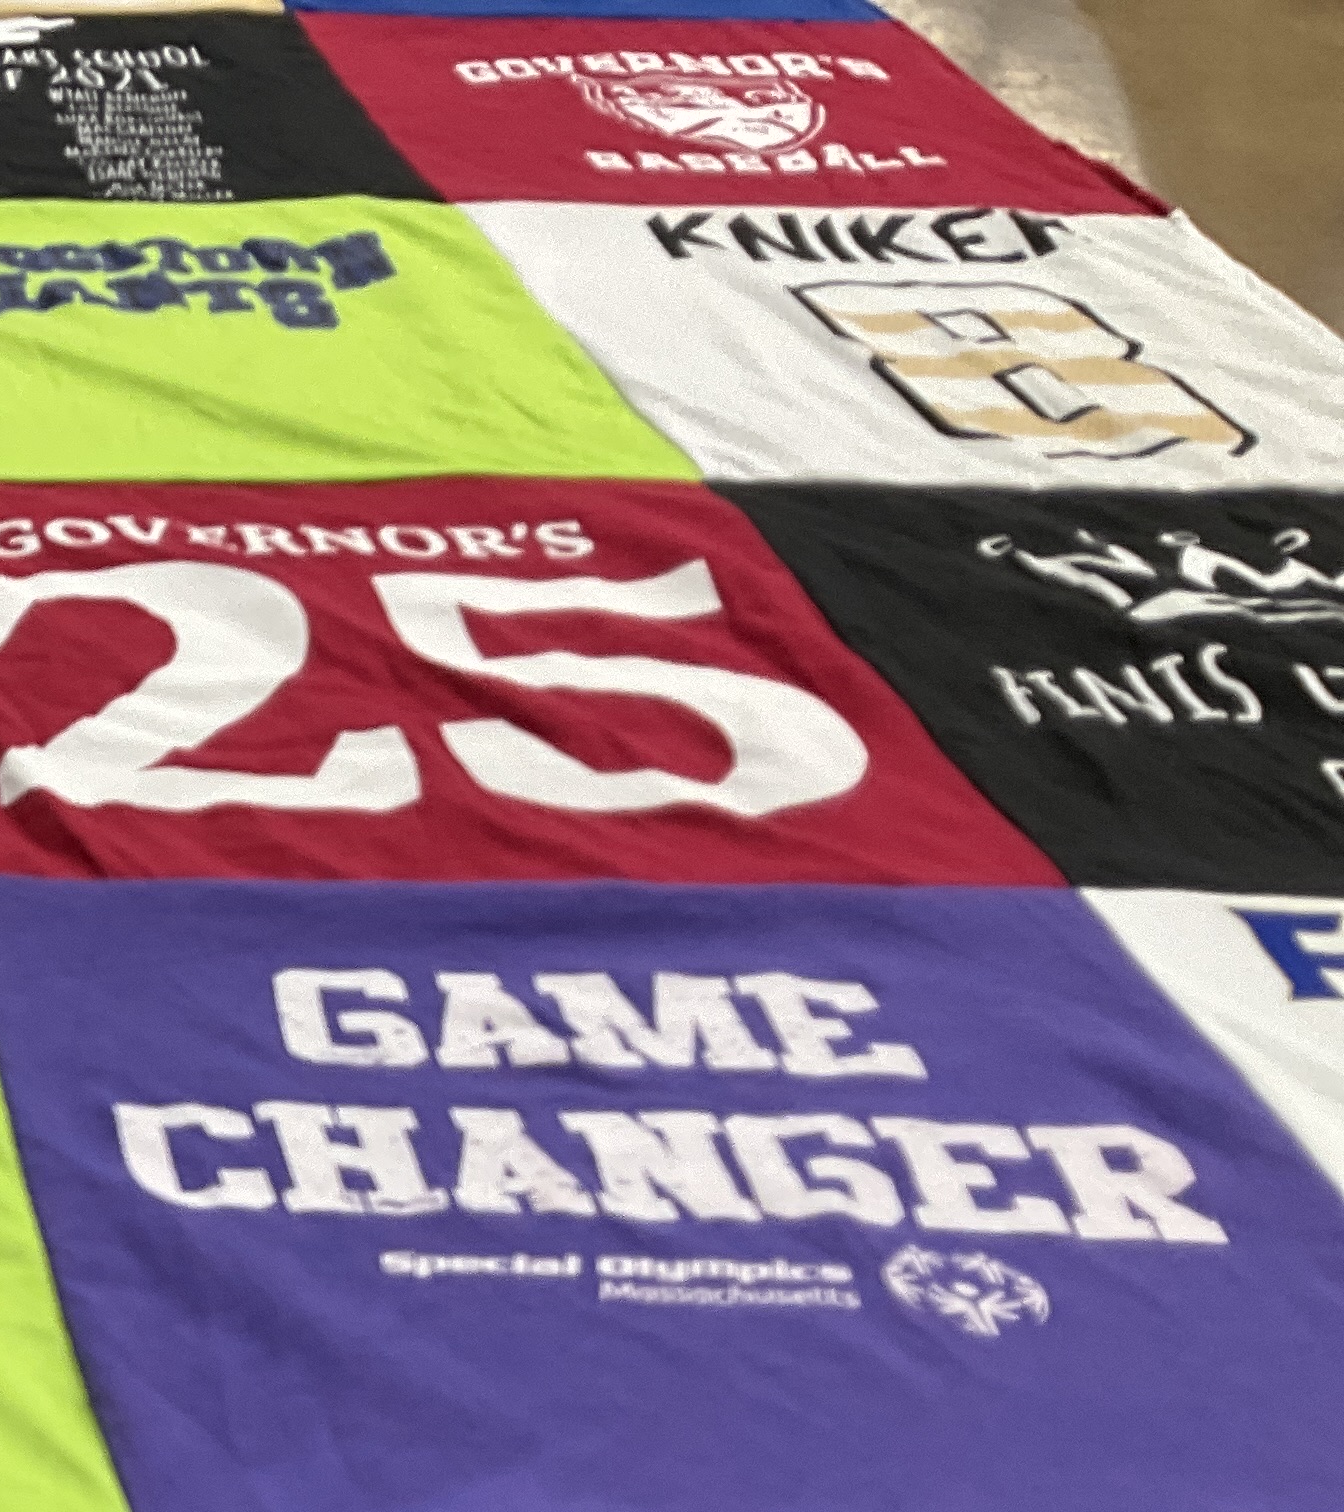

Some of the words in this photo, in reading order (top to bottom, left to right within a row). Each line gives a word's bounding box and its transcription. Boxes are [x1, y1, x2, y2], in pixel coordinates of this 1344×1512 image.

[269, 967, 929, 1080] GAME
[113, 1099, 1229, 1245] CHANGER
[379, 1250, 582, 1278] Special
[596, 1254, 853, 1284] Olympics
